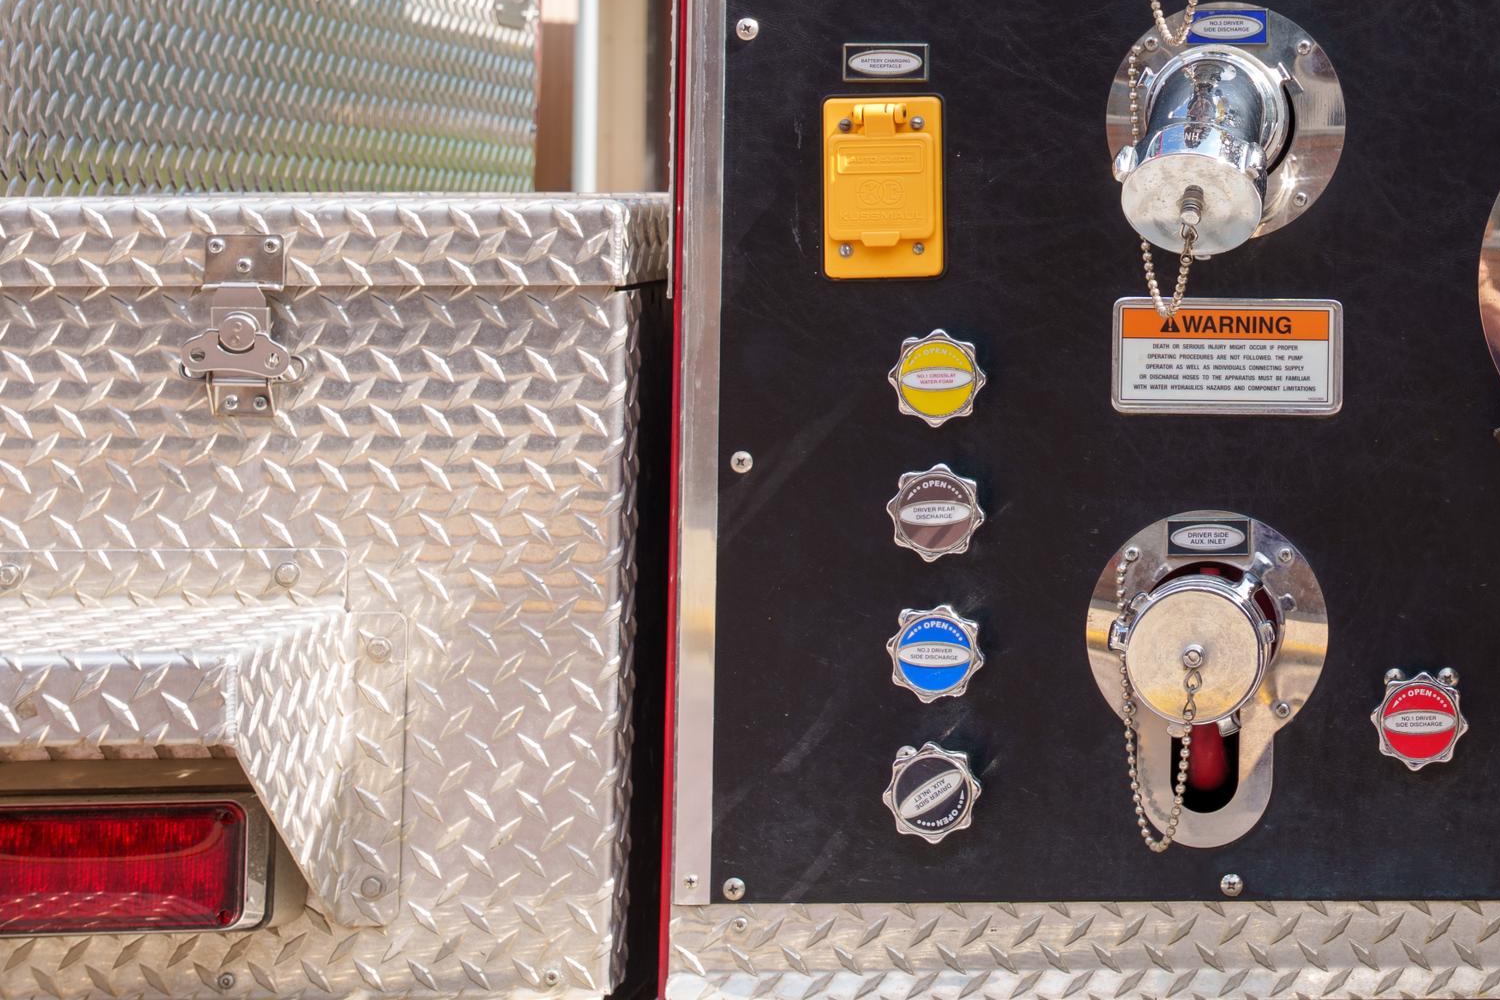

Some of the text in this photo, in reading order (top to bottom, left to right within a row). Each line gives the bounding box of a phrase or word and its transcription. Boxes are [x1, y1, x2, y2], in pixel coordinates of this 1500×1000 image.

[1183, 315, 1292, 334] WARNING
[922, 480, 947, 489] OPEN
[923, 621, 949, 629] OPEN
[1408, 688, 1432, 697] OPEN
[914, 790, 932, 803] INLET
[915, 783, 952, 811] DRIVER SIDE
[936, 809, 959, 827] OPEN
